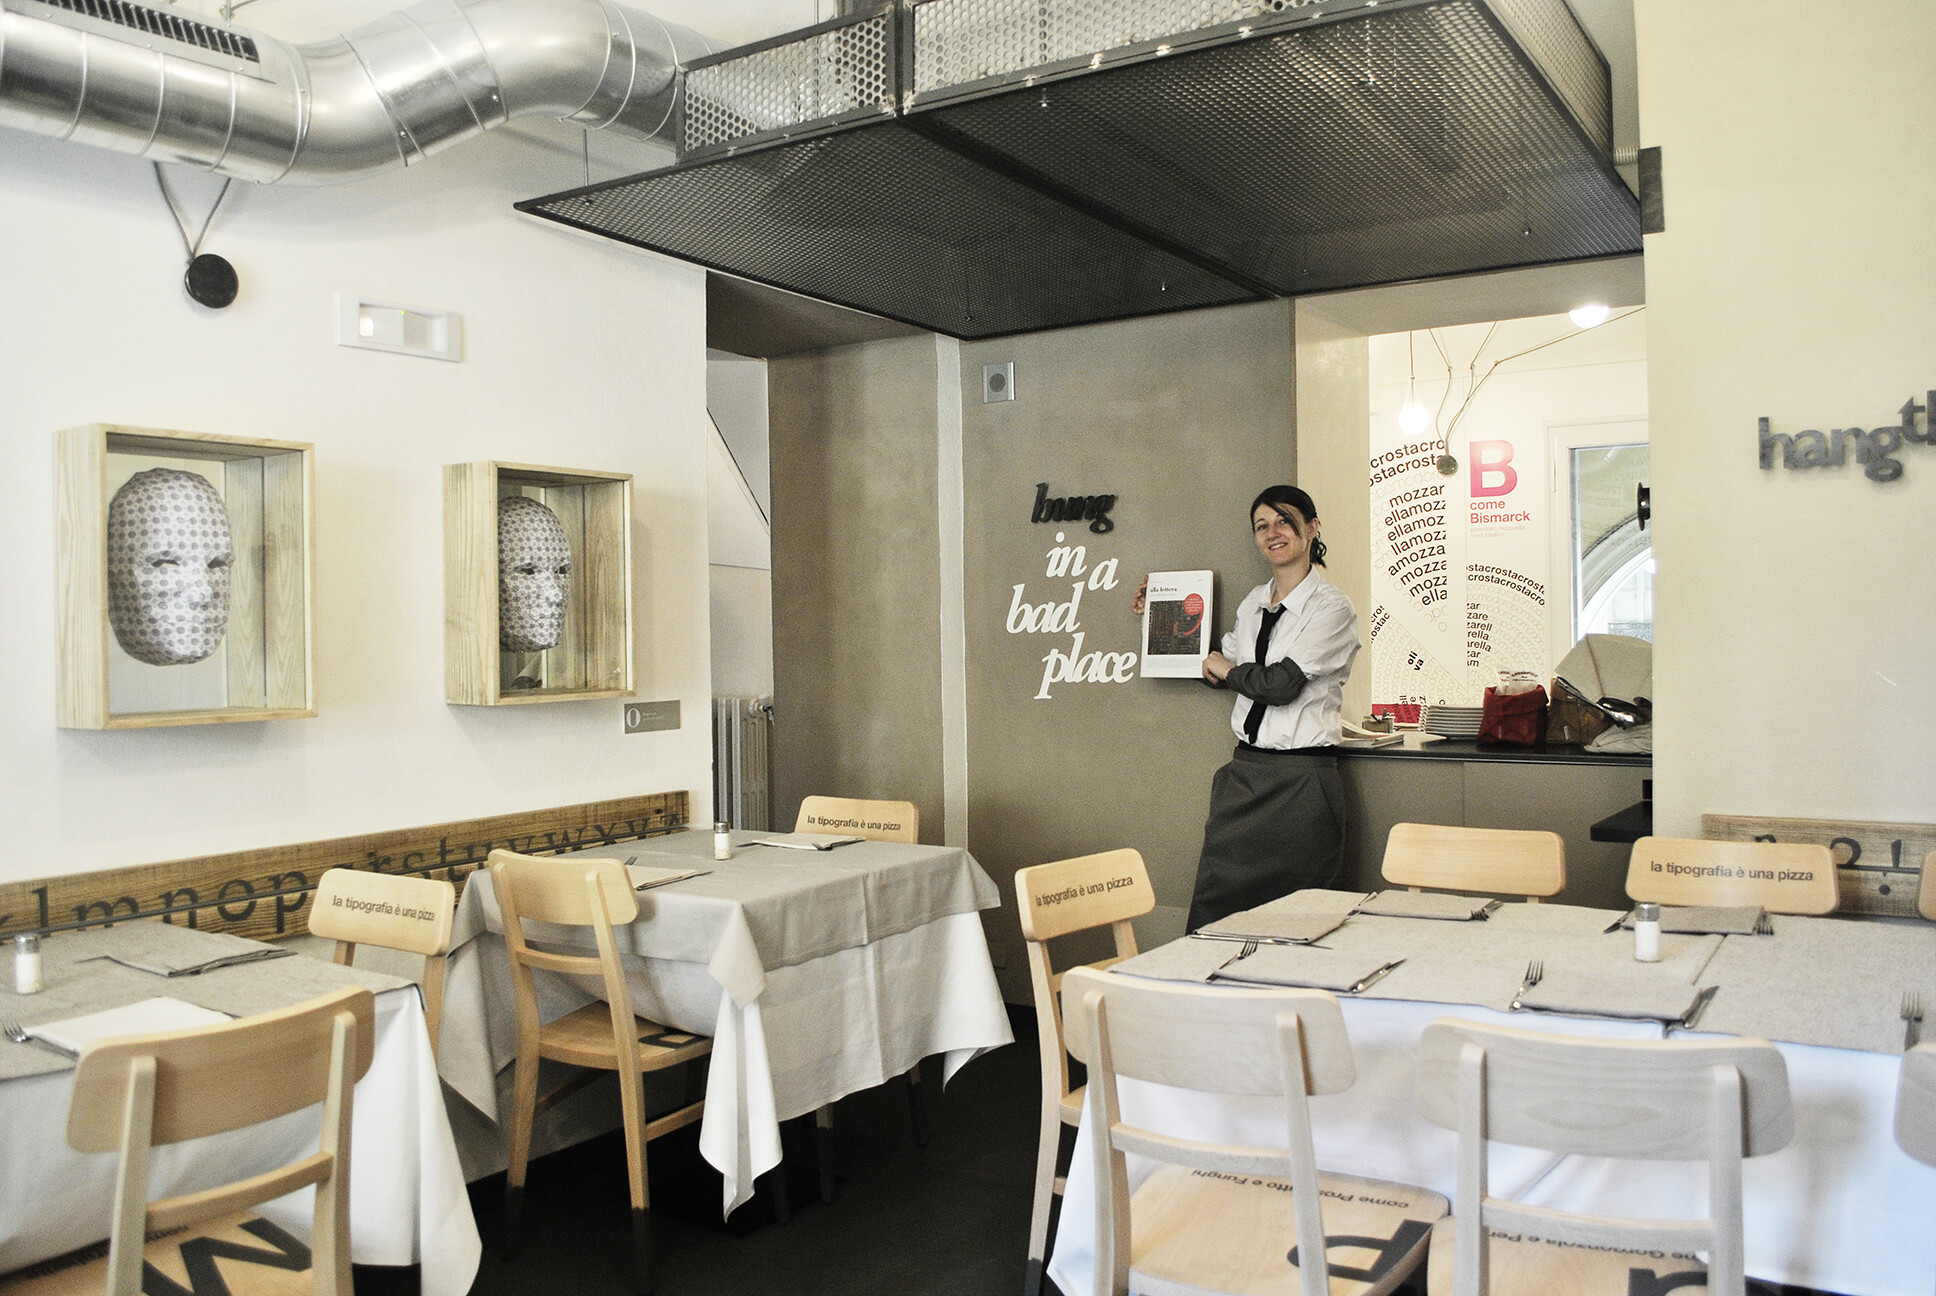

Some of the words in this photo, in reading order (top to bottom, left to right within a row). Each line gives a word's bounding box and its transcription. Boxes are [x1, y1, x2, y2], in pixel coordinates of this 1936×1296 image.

[1469, 440, 1518, 497] B
[1470, 500, 1505, 510] come
[1470, 511, 1530, 523] Bismarck
[1046, 532, 1087, 577] in
[1088, 558, 1119, 591] a
[1006, 581, 1085, 634] bad
[1034, 632, 1138, 700] place
[807, 815, 816, 824] la
[818, 816, 859, 829] tipografia
[860, 819, 866, 828] è
[867, 822, 881, 830] una
[883, 821, 901, 832] pizza
[1651, 860, 1662, 873] la
[1666, 861, 1733, 878] tipografia
[1736, 865, 1745, 878] è
[1749, 869, 1774, 881] una
[1778, 868, 1814, 883] pizza
[1035, 895, 1042, 907] la
[1042, 886, 1078, 907] tipografia
[1079, 884, 1086, 896] è
[1086, 882, 1105, 895] una
[1106, 876, 1134, 893] pizza
[332, 895, 343, 907] la
[345, 896, 393, 914] tipografia
[394, 903, 401, 915] è
[402, 907, 416, 919] una
[417, 907, 435, 921] pizza
